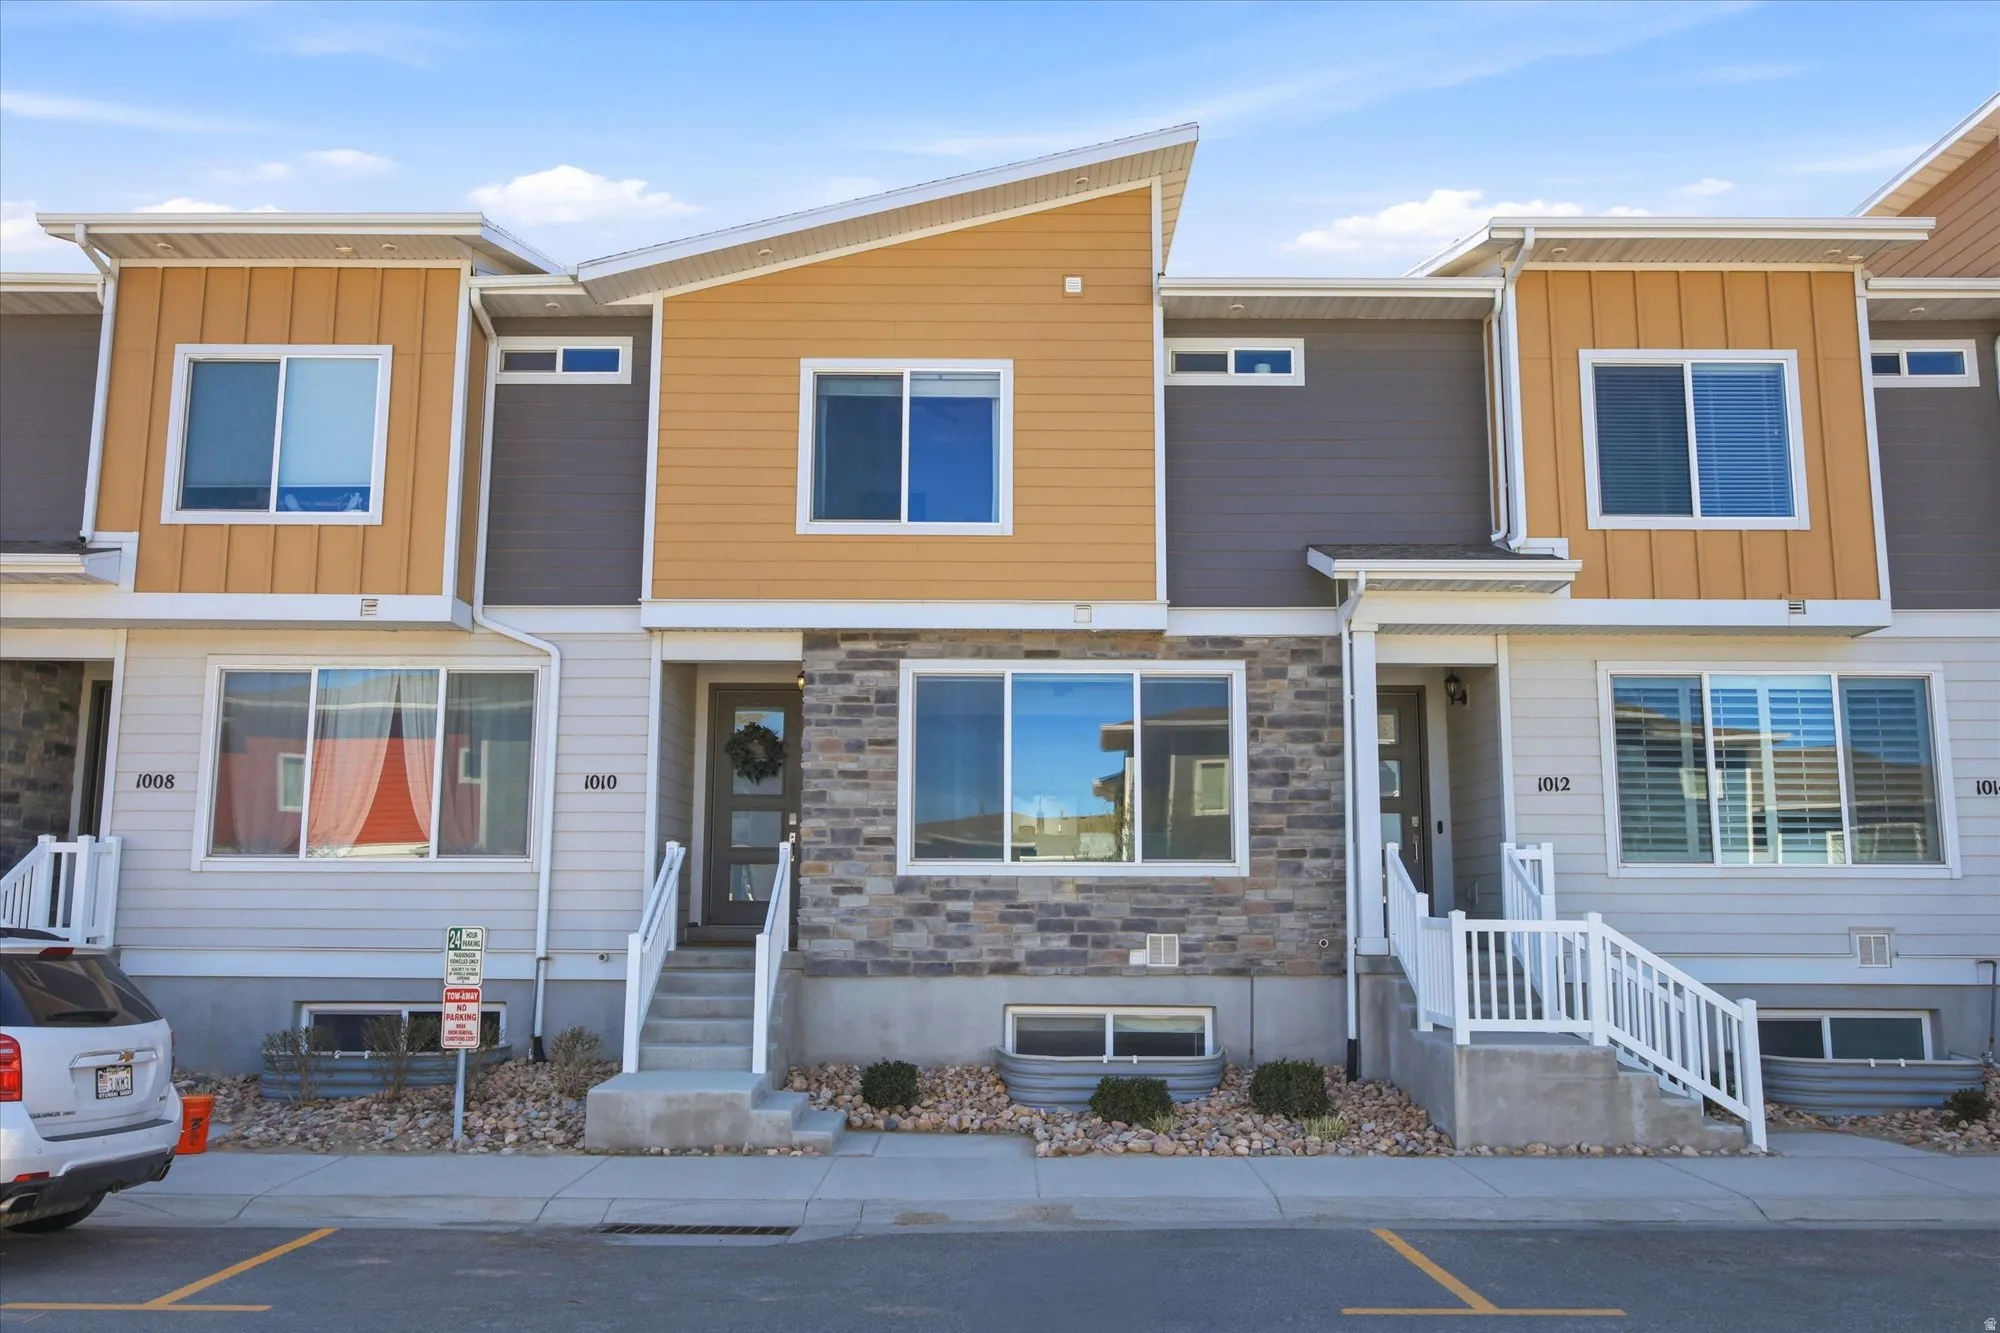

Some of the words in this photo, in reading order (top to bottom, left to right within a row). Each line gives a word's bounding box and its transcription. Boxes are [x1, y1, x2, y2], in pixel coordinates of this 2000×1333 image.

[136, 773, 175, 789] 1008
[585, 774, 617, 790] 1010
[1538, 776, 1570, 792] 1012
[1976, 780, 2000, 795] 101
[449, 930, 461, 949] 24
[447, 992, 478, 1000] TOW-AWAY
[446, 1013, 477, 1021] PARKING
